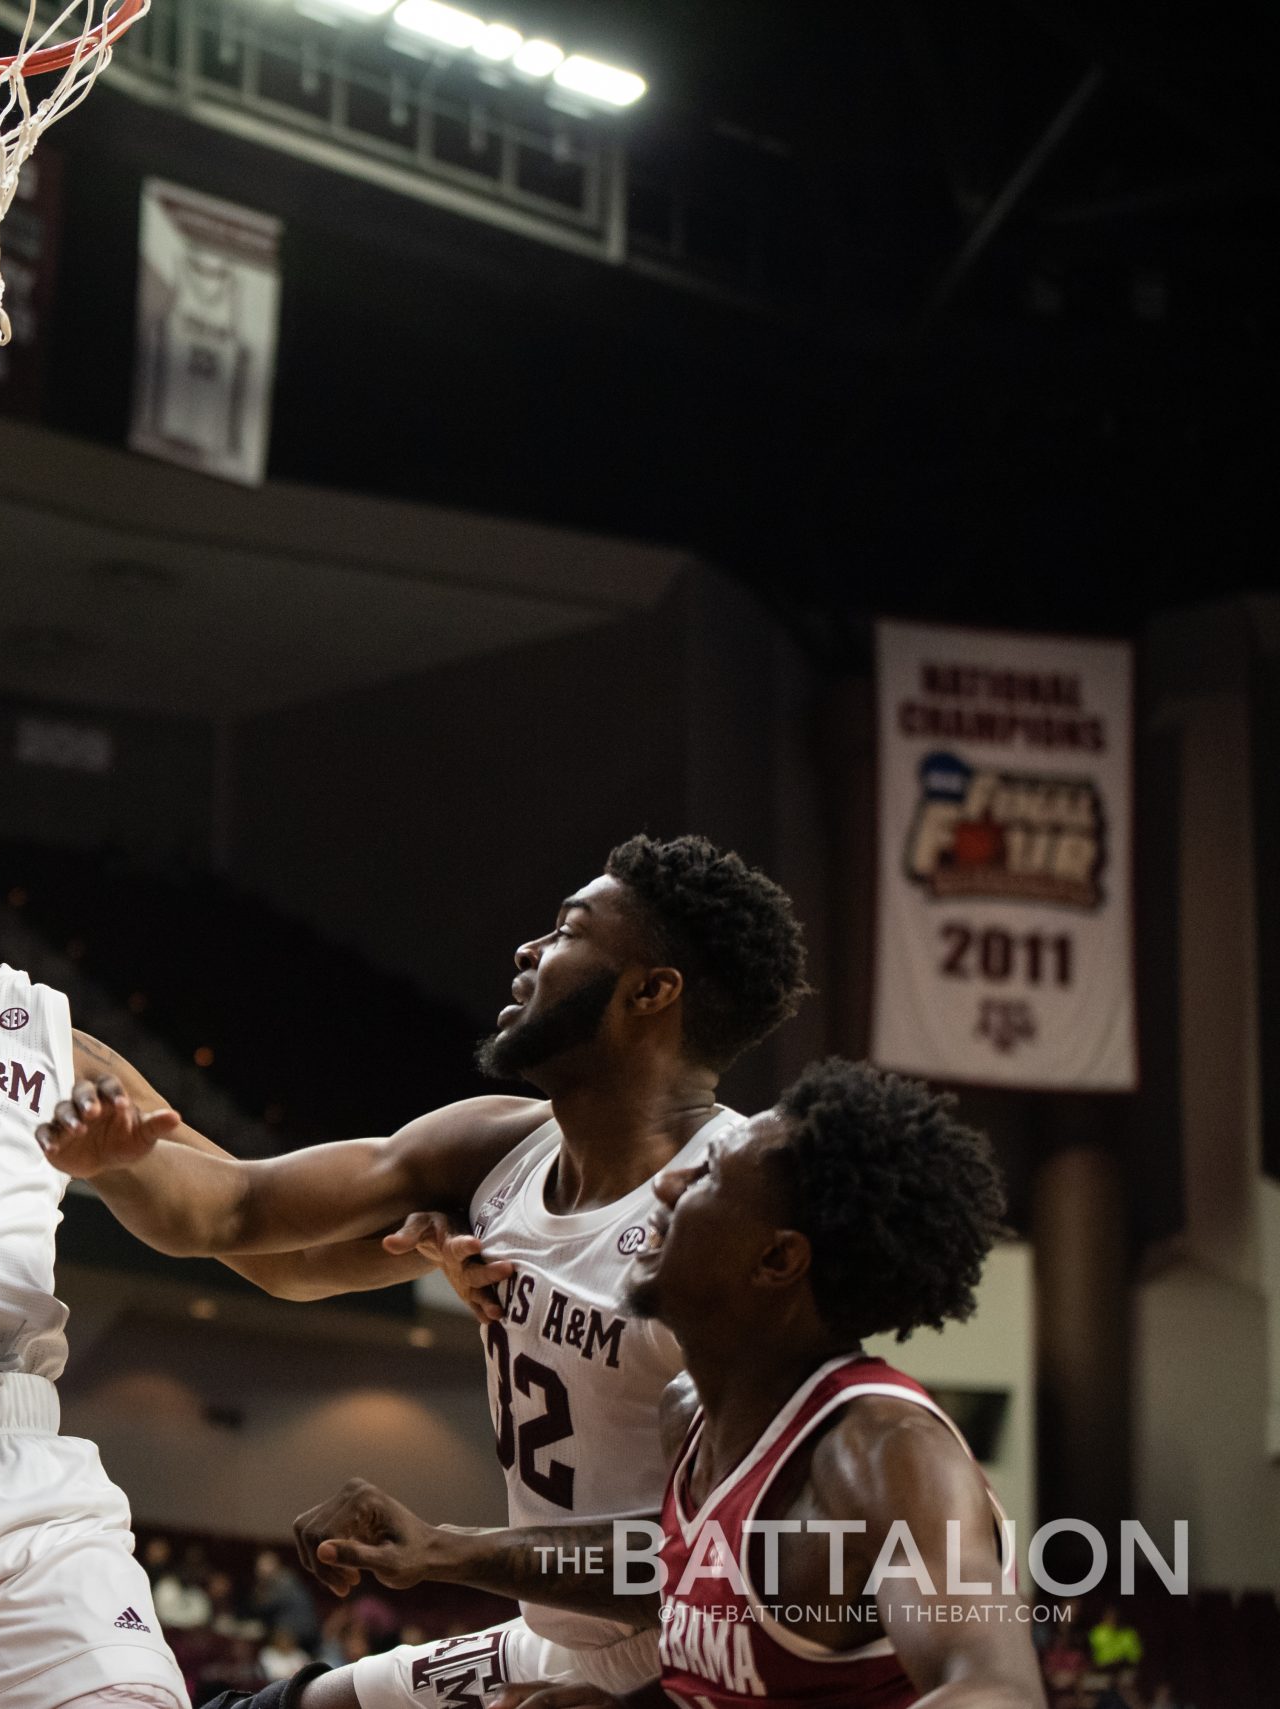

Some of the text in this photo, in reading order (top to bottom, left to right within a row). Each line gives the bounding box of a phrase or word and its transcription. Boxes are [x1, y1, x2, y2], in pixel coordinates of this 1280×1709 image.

[921, 663, 1081, 707] NATIONAL
[899, 703, 1107, 753] CHAMPIONS
[940, 920, 1071, 988] 2011
[0, 1008, 28, 1029] SEC
[542, 1286, 626, 1369] A&M
